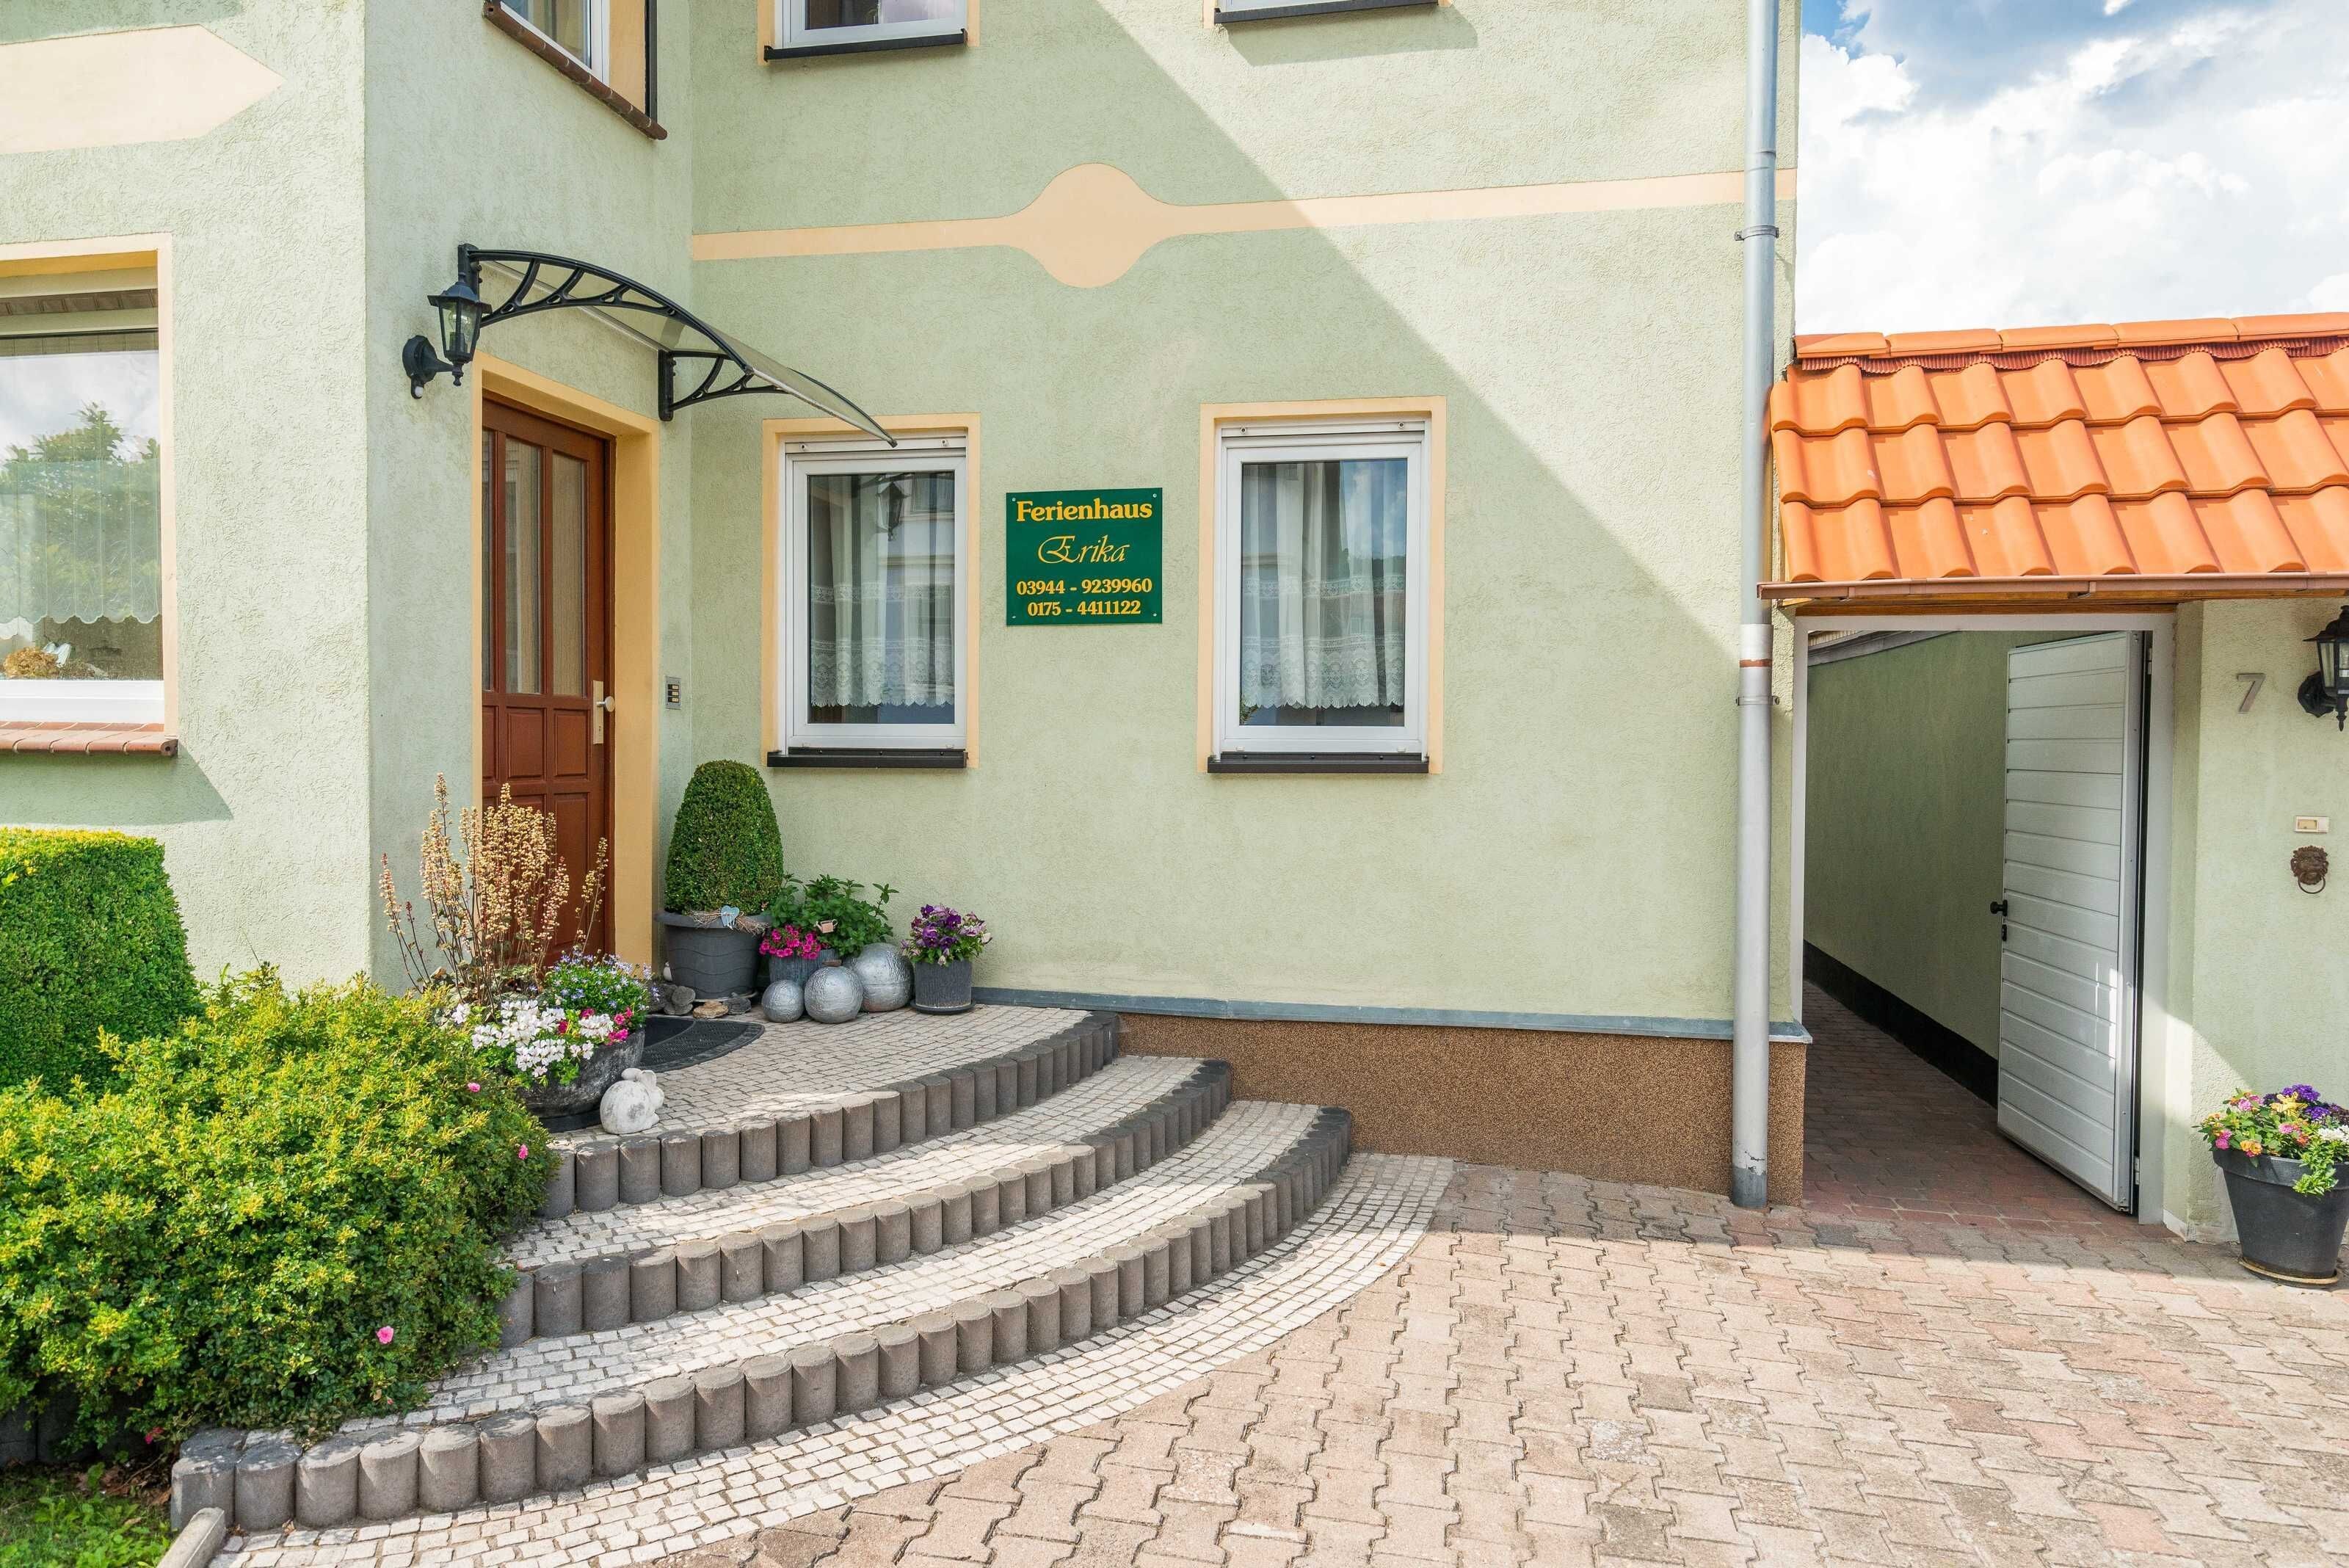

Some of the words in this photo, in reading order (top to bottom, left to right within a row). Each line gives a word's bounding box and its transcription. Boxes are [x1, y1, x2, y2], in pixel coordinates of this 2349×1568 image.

[1017, 498, 1152, 522] Ferienhaus
[1038, 534, 1130, 564] Erika
[1016, 580, 1066, 595] 03944
[1081, 578, 1152, 594] 9239960
[1028, 602, 1061, 616] 0175
[1077, 600, 1141, 615] 4411122
[2237, 672, 2266, 713] 7
